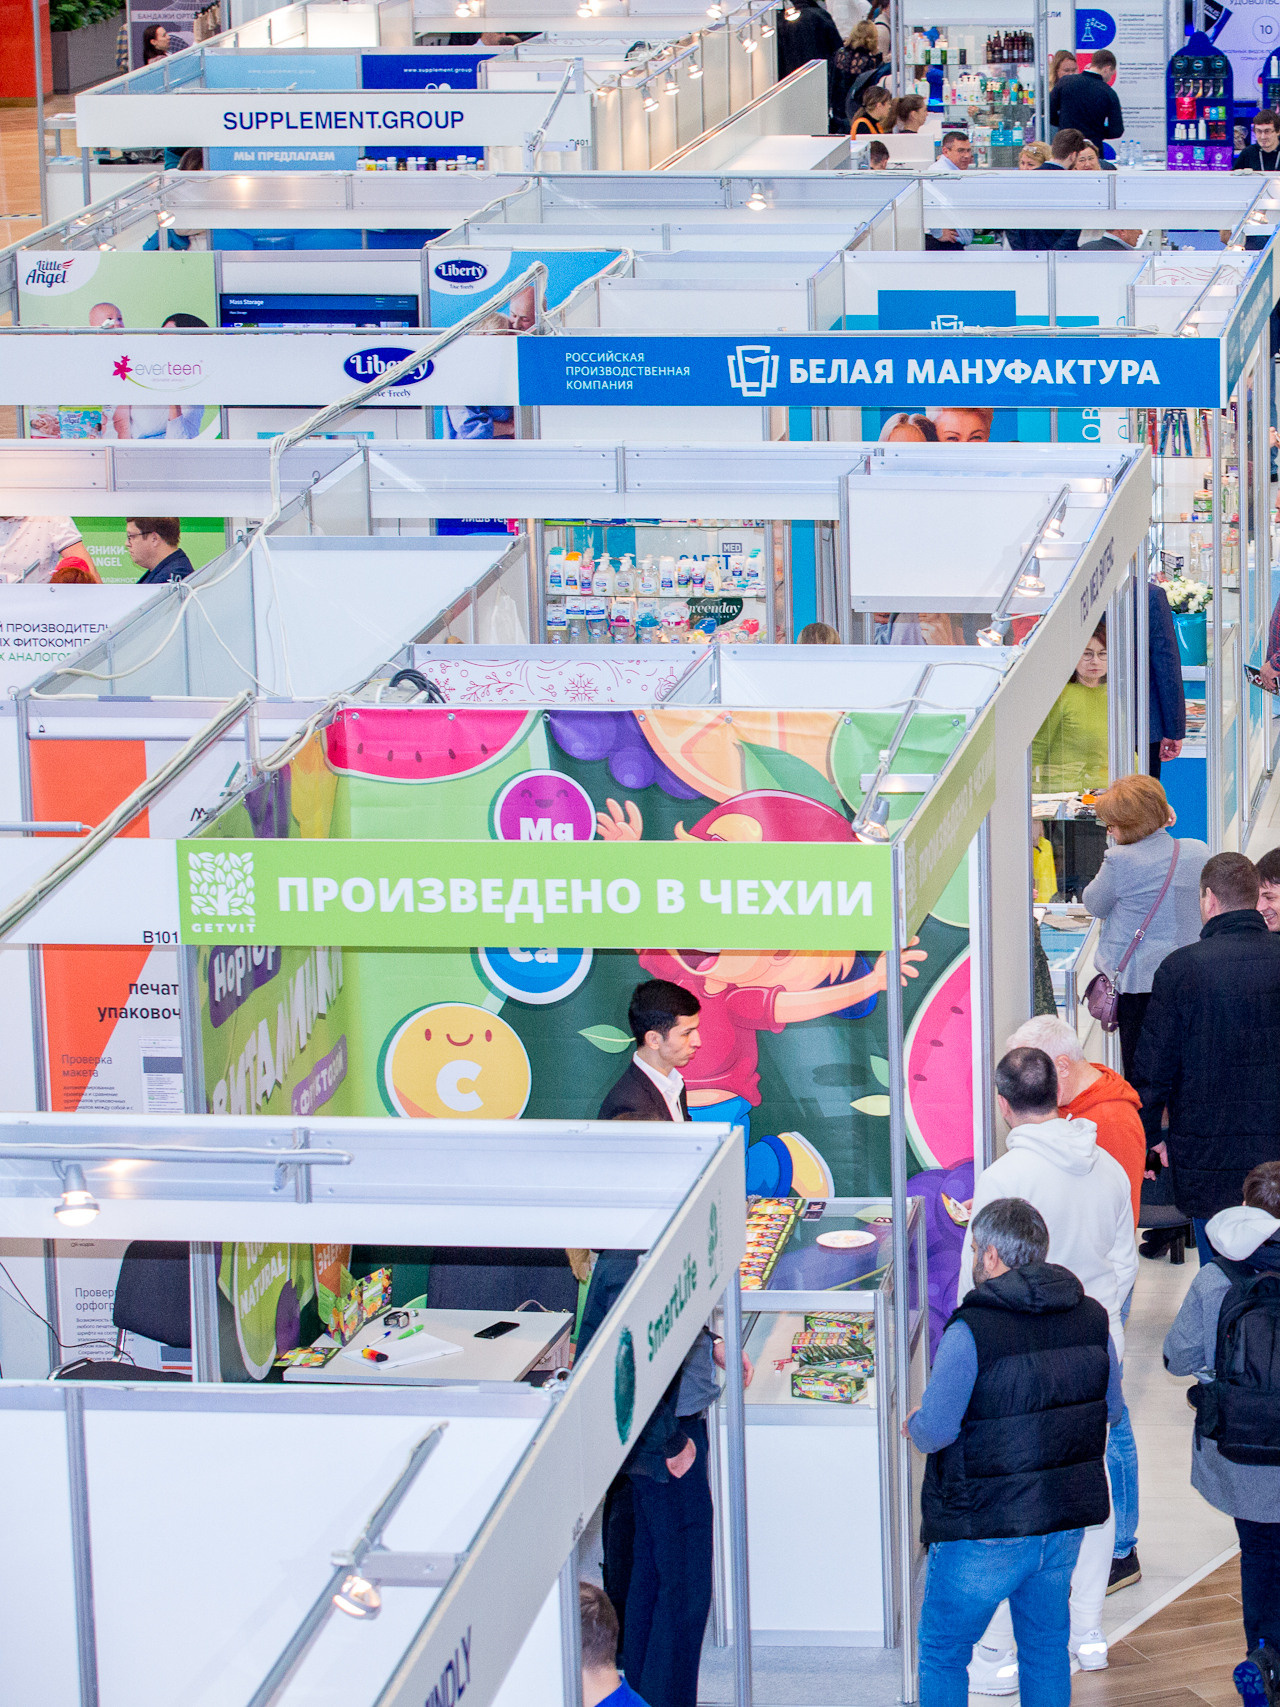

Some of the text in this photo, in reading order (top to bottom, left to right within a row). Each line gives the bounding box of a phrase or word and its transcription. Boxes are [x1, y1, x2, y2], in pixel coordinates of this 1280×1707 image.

[1259, 25, 1273, 34] 10
[223, 110, 464, 130] SUPPLEMENT.GROUP
[233, 151, 335, 162] МЫ ПРЕДЛАГАЕМ
[36, 260, 62, 272] Little
[438, 263, 485, 279] Liberty
[25, 269, 67, 288] Angel
[565, 350, 645, 362] РОССИЙСКАЯ
[135, 361, 202, 376] everteen
[350, 354, 429, 380] Libey
[565, 366, 690, 377] ПРОИЗВОДСТВЕННАЯ
[789, 358, 1161, 385] БЕЛАЯ МАНУФАКТУРА
[566, 380, 633, 390] КОМПАНИЯ
[723, 543, 742, 552] MED
[689, 602, 741, 615] reenday
[8, 652, 71, 662] АНАЛОГО
[277, 876, 873, 924] ПРОИЗВЕДЕНО В ЧЕХИИ
[191, 923, 256, 933] GETVIT
[143, 931, 179, 944] B101
[129, 983, 179, 996] печат
[97, 1006, 181, 1022] упаковоч
[61, 1054, 113, 1066] Проверка
[62, 1069, 99, 1078] макета
[436, 1059, 484, 1112] C
[239, 1250, 286, 1319] NATURAL
[648, 1252, 698, 1363] SmartLife
